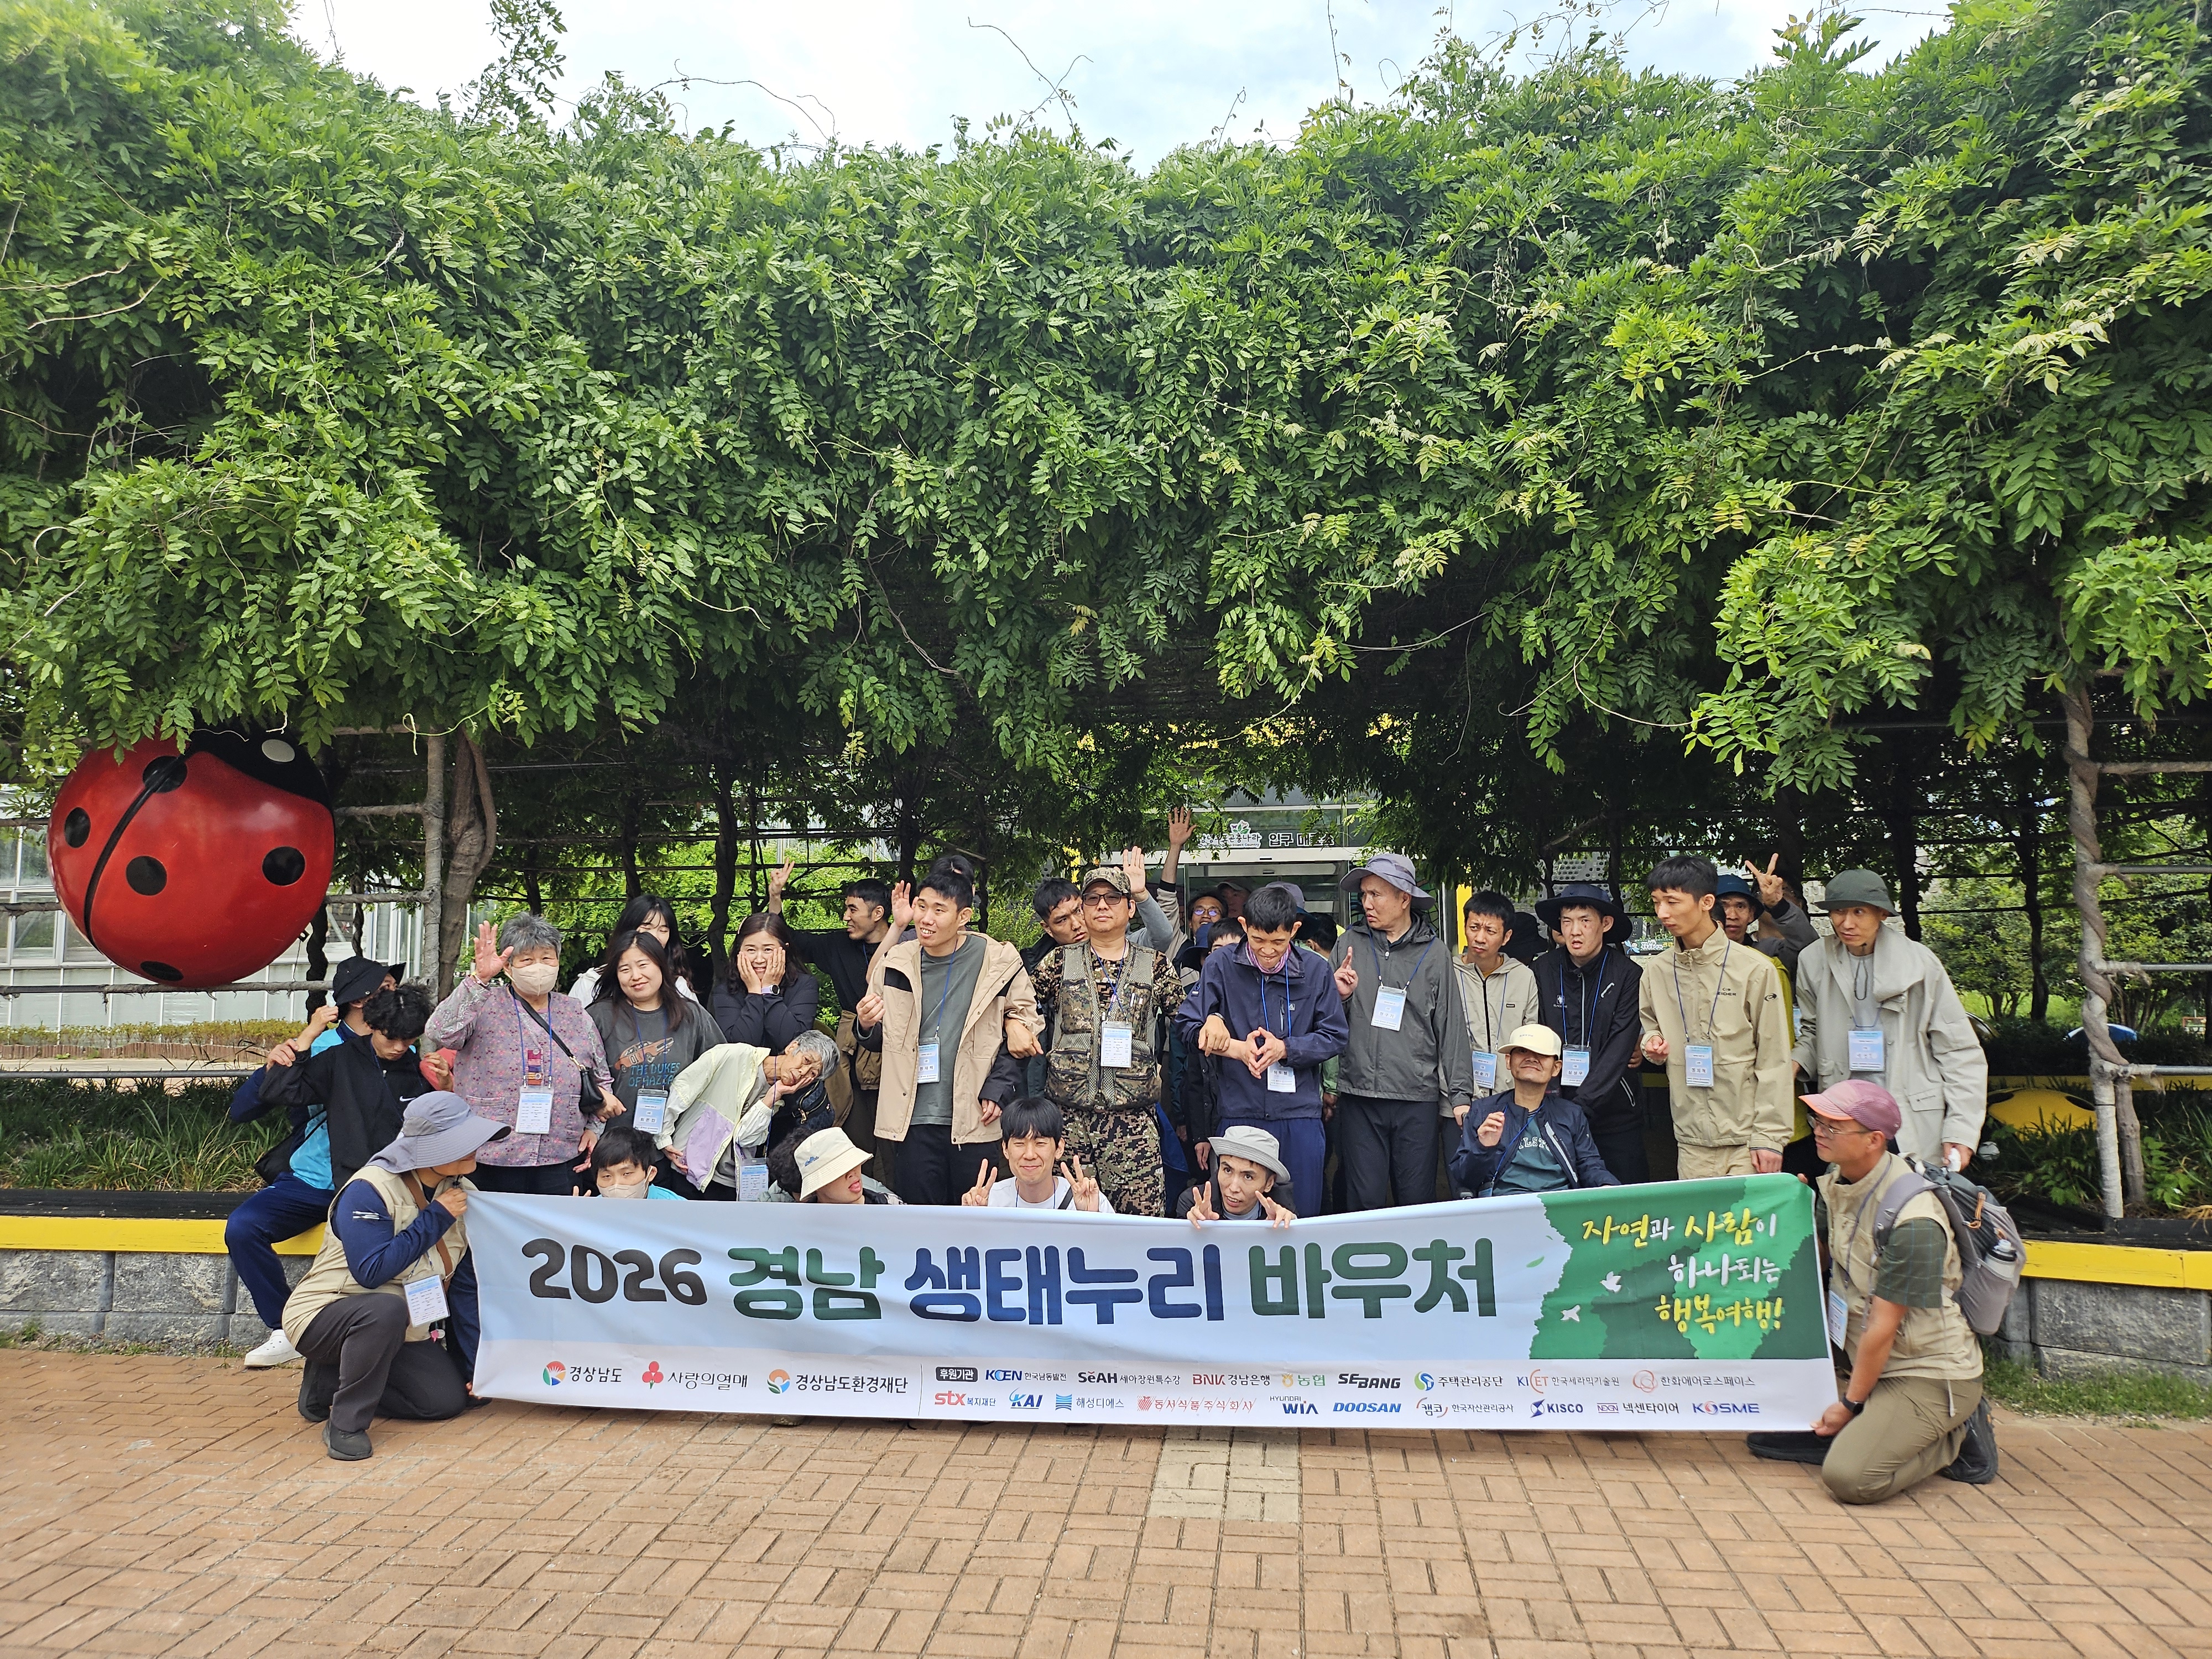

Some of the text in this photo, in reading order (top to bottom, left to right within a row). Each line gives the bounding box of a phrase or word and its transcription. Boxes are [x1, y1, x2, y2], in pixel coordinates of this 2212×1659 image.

[1269, 833, 1335, 847] 입구 매소
[630, 1054, 639, 1064] 01
[630, 1062, 681, 1075] THE DUKES
[628, 1074, 674, 1087] OF HAZZA
[1582, 1208, 1777, 1248] 자연과 사람이
[1667, 1253, 1780, 1289] 하나되는
[521, 1237, 708, 1306] 2026
[727, 1244, 885, 1321] 경남
[904, 1244, 1225, 1326] 생태누리
[1248, 1238, 1498, 1319] 바우처
[1654, 1293, 1783, 1334] 행복여행!
[570, 1366, 622, 1383] 경상남도
[940, 1368, 974, 1380] 후원기관
[985, 1369, 1067, 1381] KOEN 한국남동발전
[1119, 1374, 1181, 1385] 세아창원특수강
[1192, 1374, 1270, 1386] BNK 경남은행
[1297, 1374, 1326, 1386] 농협
[667, 1371, 748, 1390] 사랑의열매
[796, 1374, 909, 1394] 경상남도환경재단
[1337, 1373, 1401, 1389] SEBANG
[1437, 1376, 1504, 1387] 주택관리공단
[1552, 1376, 1620, 1386] 한국세라믹기술원
[1660, 1376, 1756, 1387] 한화에어로스페이스
[967, 1397, 996, 1406] 복지재단
[1010, 1391, 1043, 1408] KAI
[1076, 1397, 1125, 1409] 해성디에스
[1333, 1402, 1402, 1413] DOOSAN
[1421, 1403, 1514, 1416] 캠코 한국자산관리공사
[1547, 1403, 1584, 1413] KISCO
[1623, 1402, 1680, 1414] 넥센타이어
[1692, 1402, 1760, 1414] KOSME
